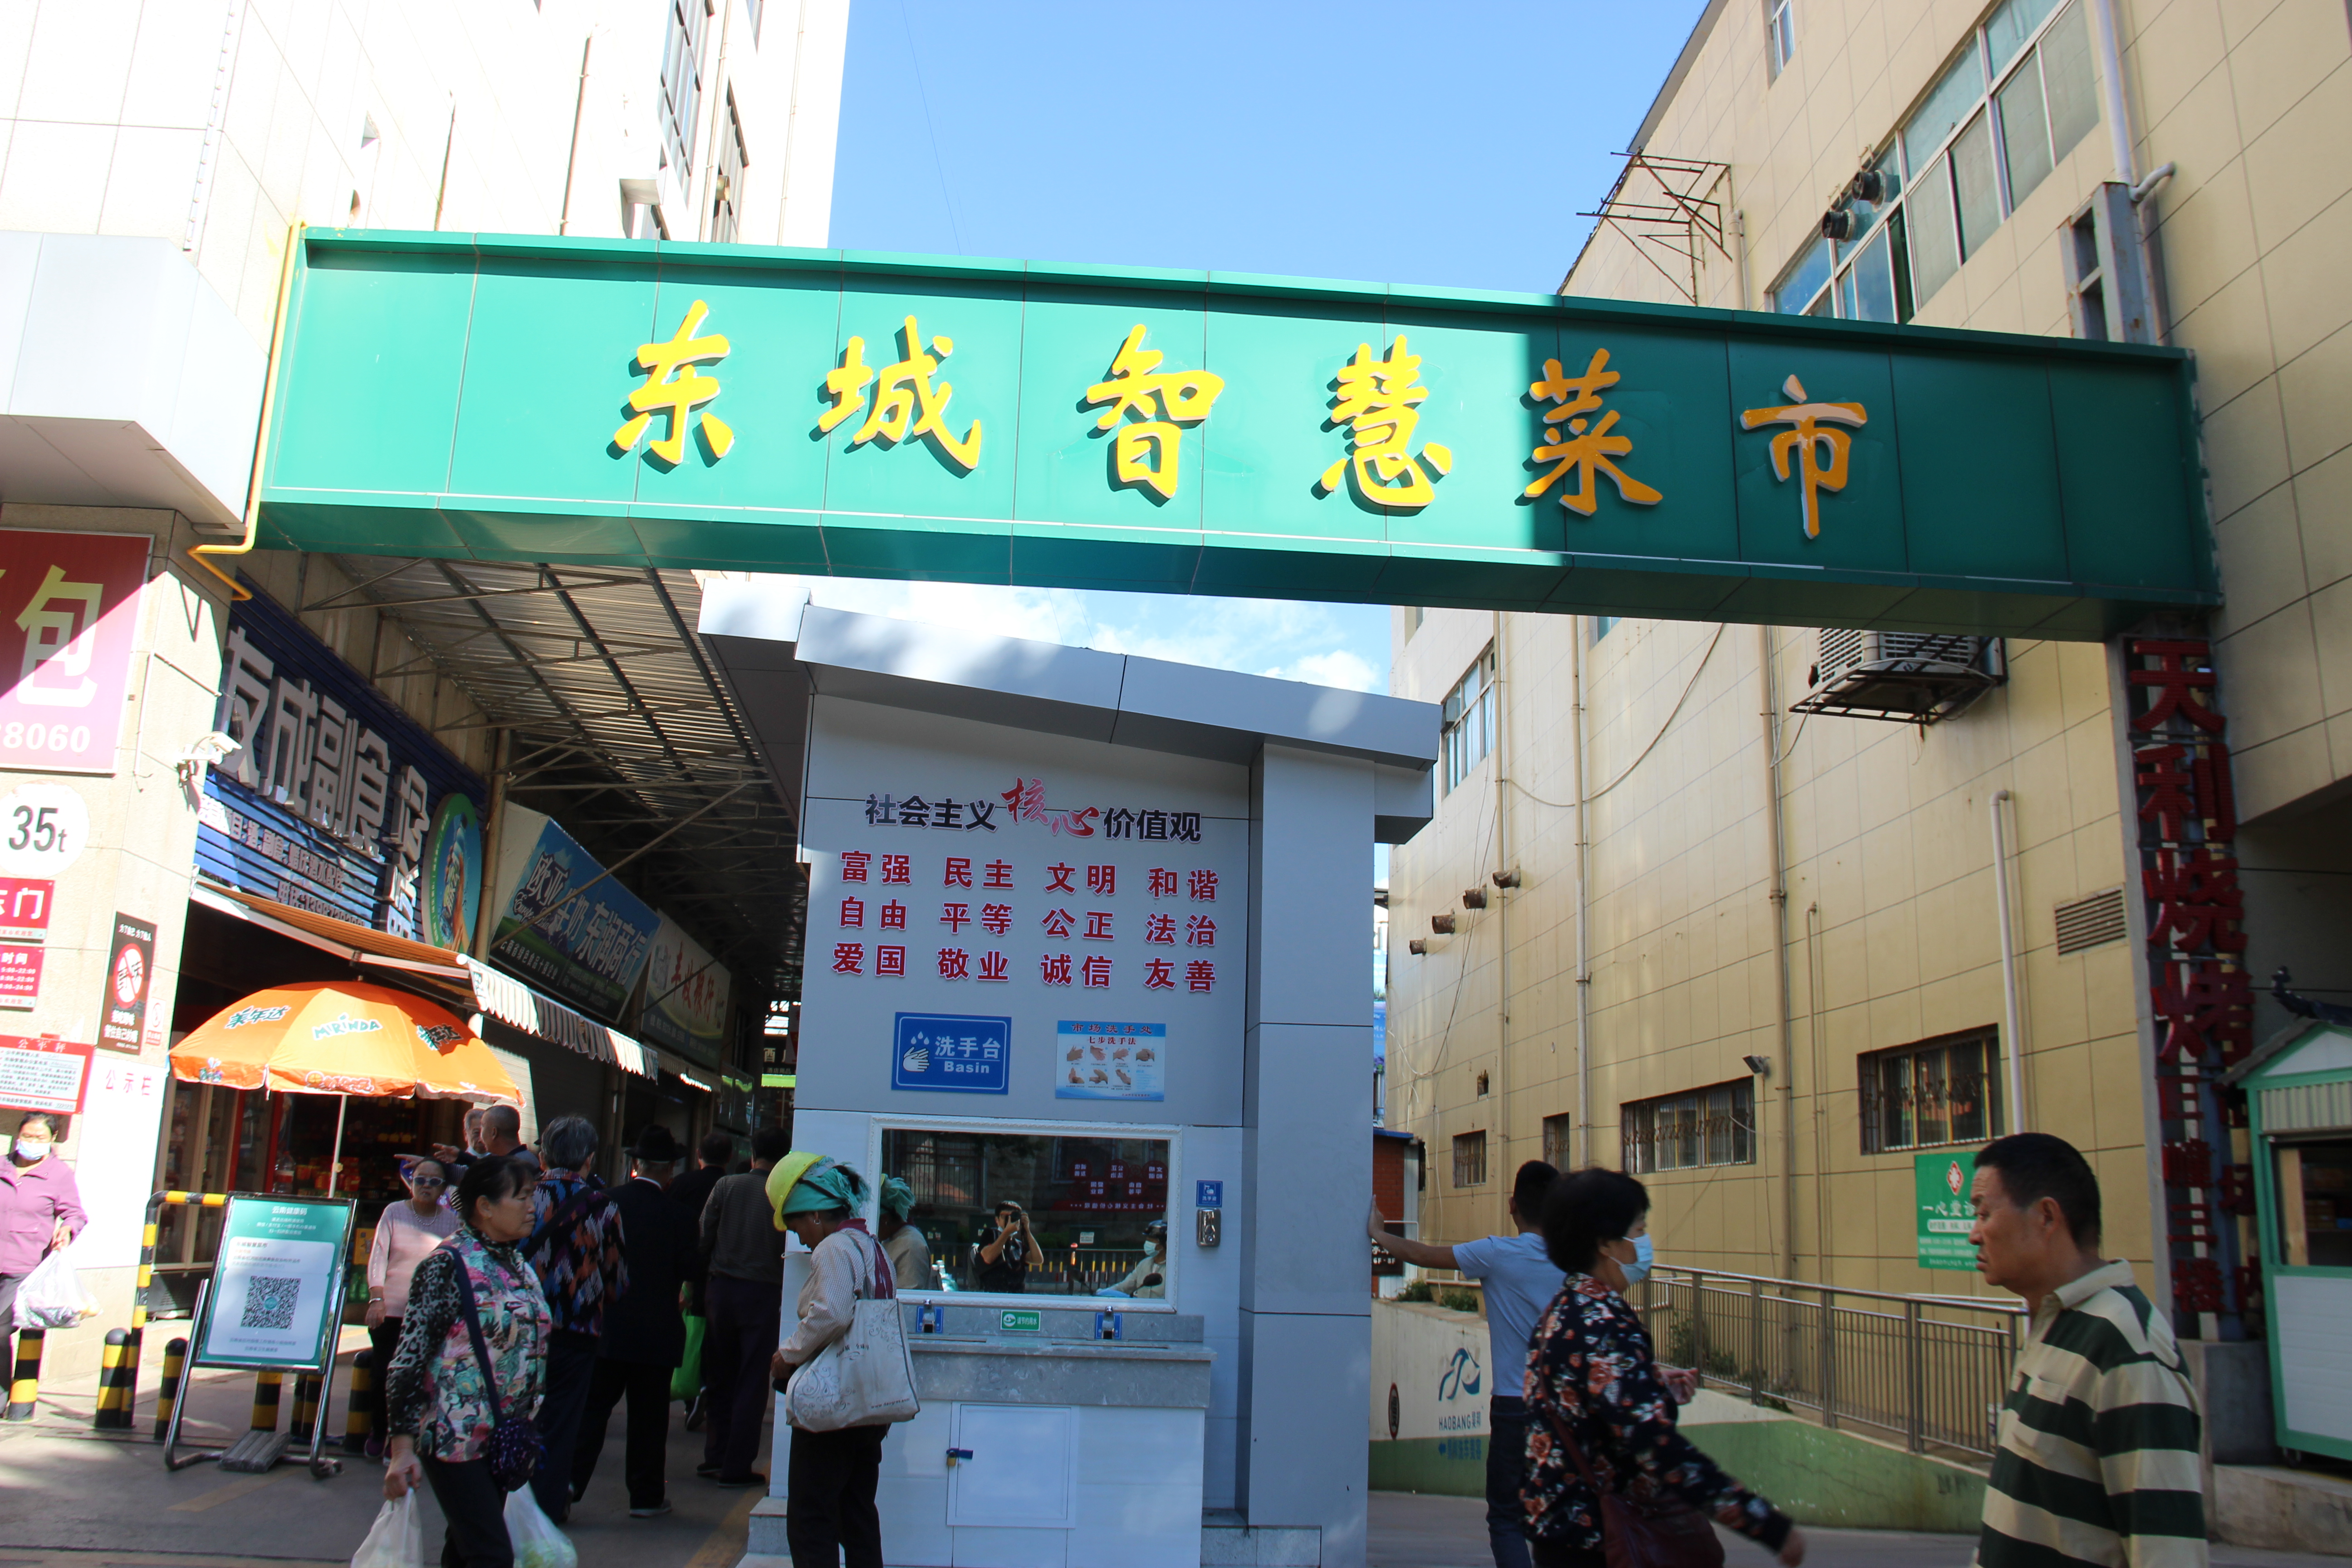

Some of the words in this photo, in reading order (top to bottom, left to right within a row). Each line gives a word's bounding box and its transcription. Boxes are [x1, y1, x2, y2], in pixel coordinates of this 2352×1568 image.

[612, 299, 1868, 540] 东城智慧菜市
[865, 776, 1202, 844] 社会主义核心价值观
[528, 855, 570, 906] 欧亚
[840, 851, 911, 886] 富强
[943, 856, 1014, 890] 民主
[1044, 862, 1116, 896] 文明
[1147, 867, 1219, 902] 和谐
[839, 896, 906, 931] 自由
[939, 902, 1014, 936] 平等
[1040, 908, 1115, 941] 公正
[1145, 913, 1218, 947] 法治
[575, 902, 648, 986] 东润商行
[832, 942, 906, 977] 爱国
[937, 947, 1009, 982] 敬业
[1040, 953, 1113, 988] 诚信
[1144, 957, 1216, 993] 友善
[225, 1005, 291, 1029] 美年达
[1071, 1023, 1152, 1034] 市场洗手处
[935, 1035, 1001, 1059] 洗手台
[1087, 1036, 1137, 1045] 七步洗手法
[944, 1060, 990, 1074] Basin
[271, 1205, 308, 1216] 云南健康码
[1439, 1414, 1471, 1431] HAOBANG
